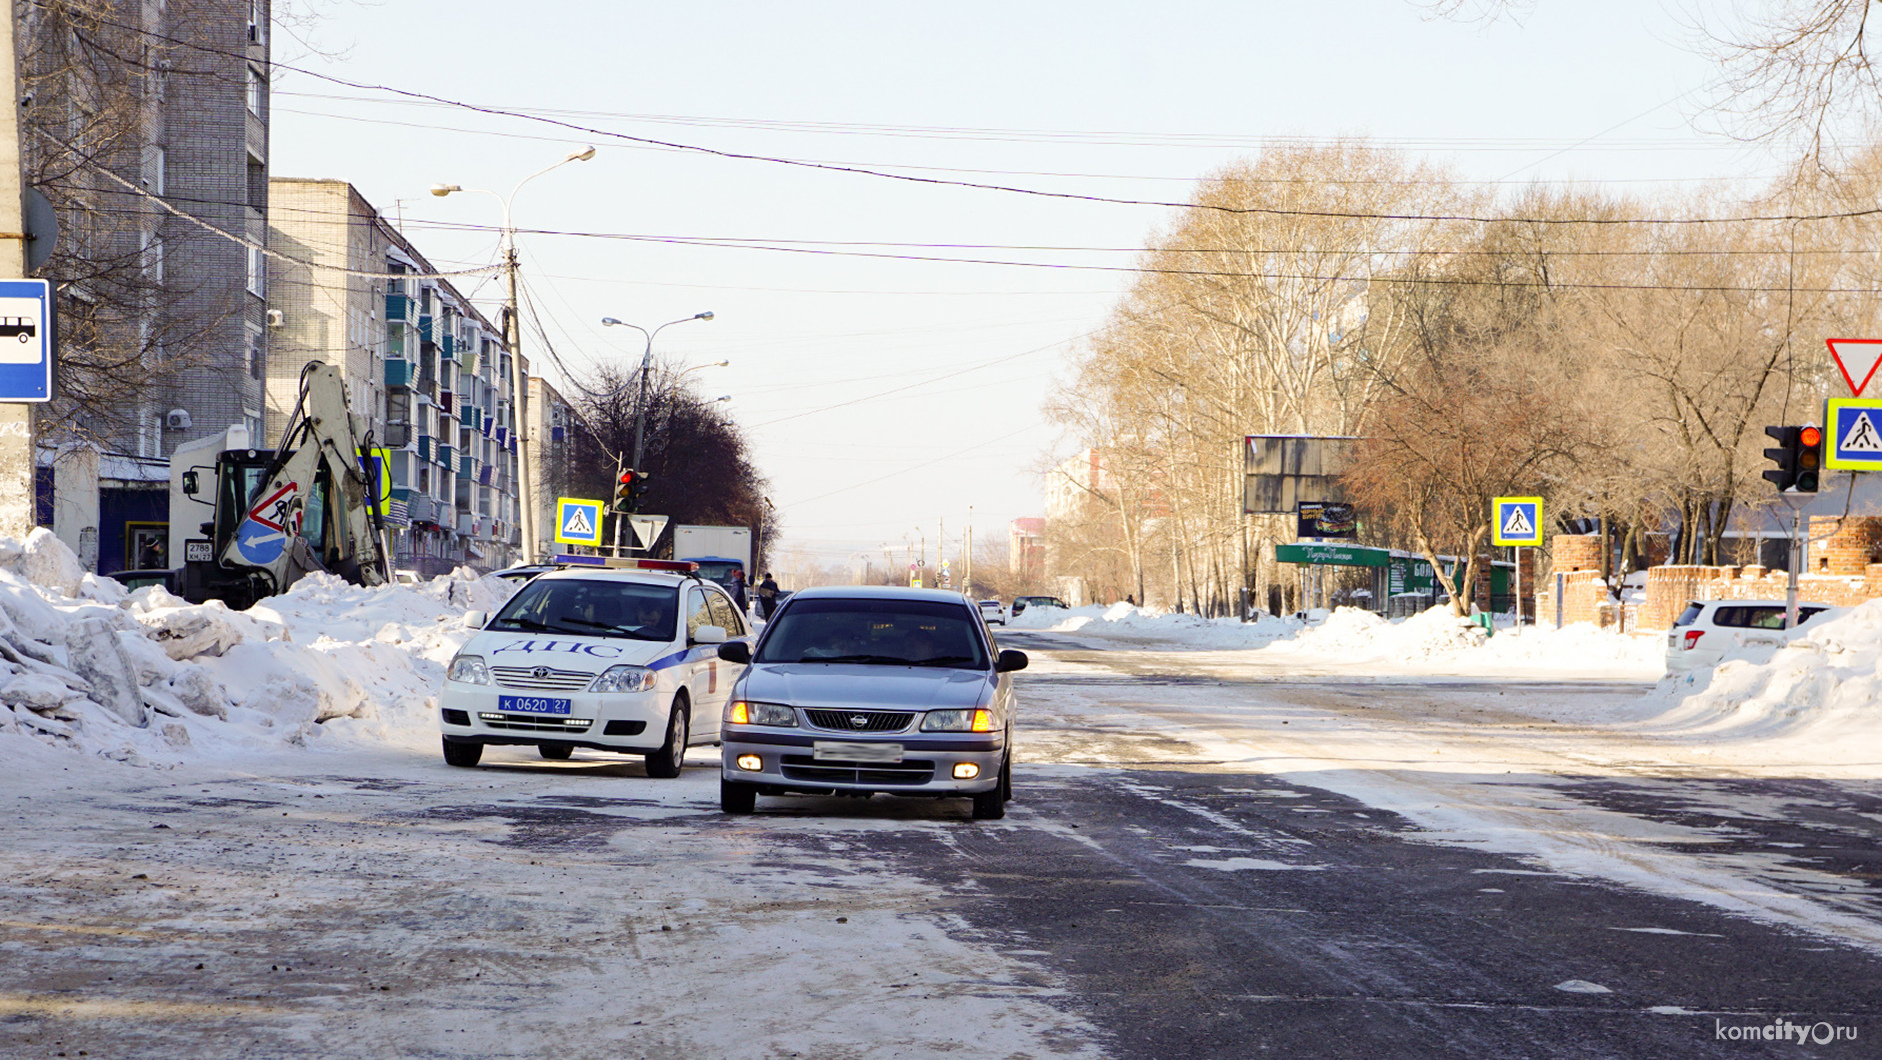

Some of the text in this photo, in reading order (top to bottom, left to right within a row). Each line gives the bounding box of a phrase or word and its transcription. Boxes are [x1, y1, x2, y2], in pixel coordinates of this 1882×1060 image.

[189, 544, 210, 552] 2788
[493, 640, 623, 658] ДПС
[516, 698, 548, 711] 0620
[554, 700, 567, 710] 27
